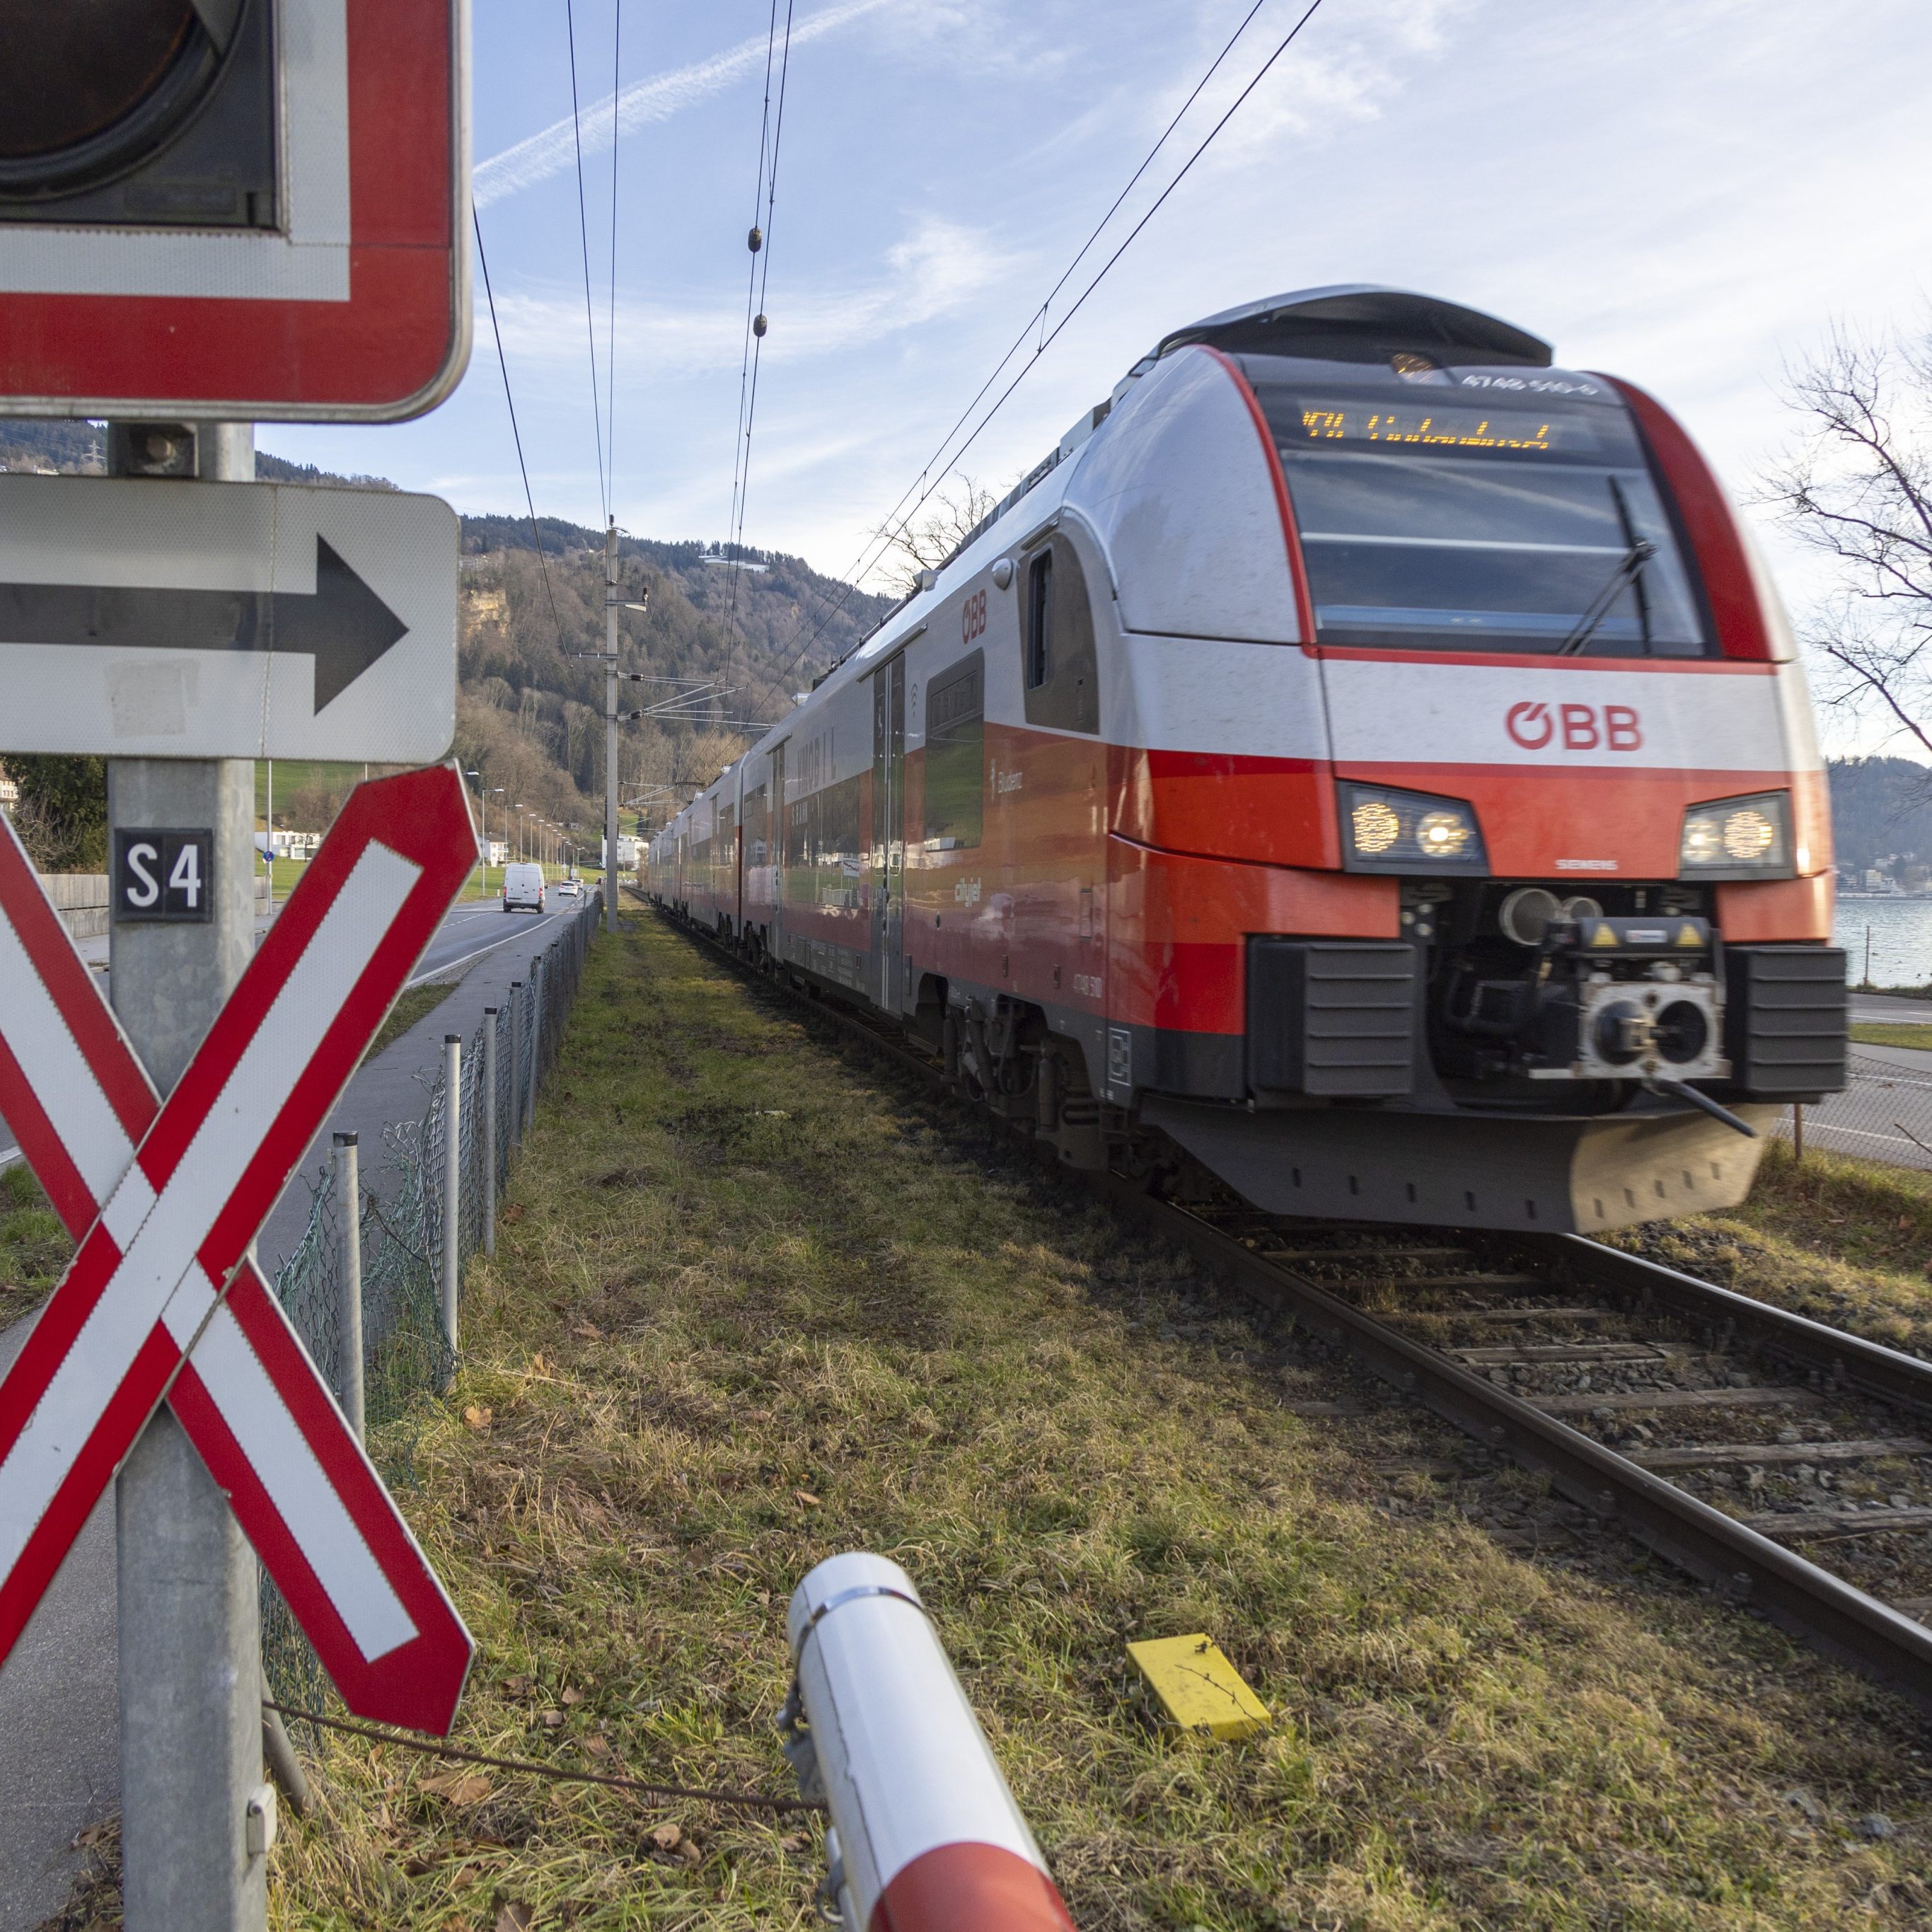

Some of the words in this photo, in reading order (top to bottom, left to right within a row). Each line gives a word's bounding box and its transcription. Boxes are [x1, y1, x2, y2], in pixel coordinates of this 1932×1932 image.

[962, 589, 987, 644] ÖBB
[1506, 701, 1645, 751] ÖBB
[127, 843, 202, 908] S4
